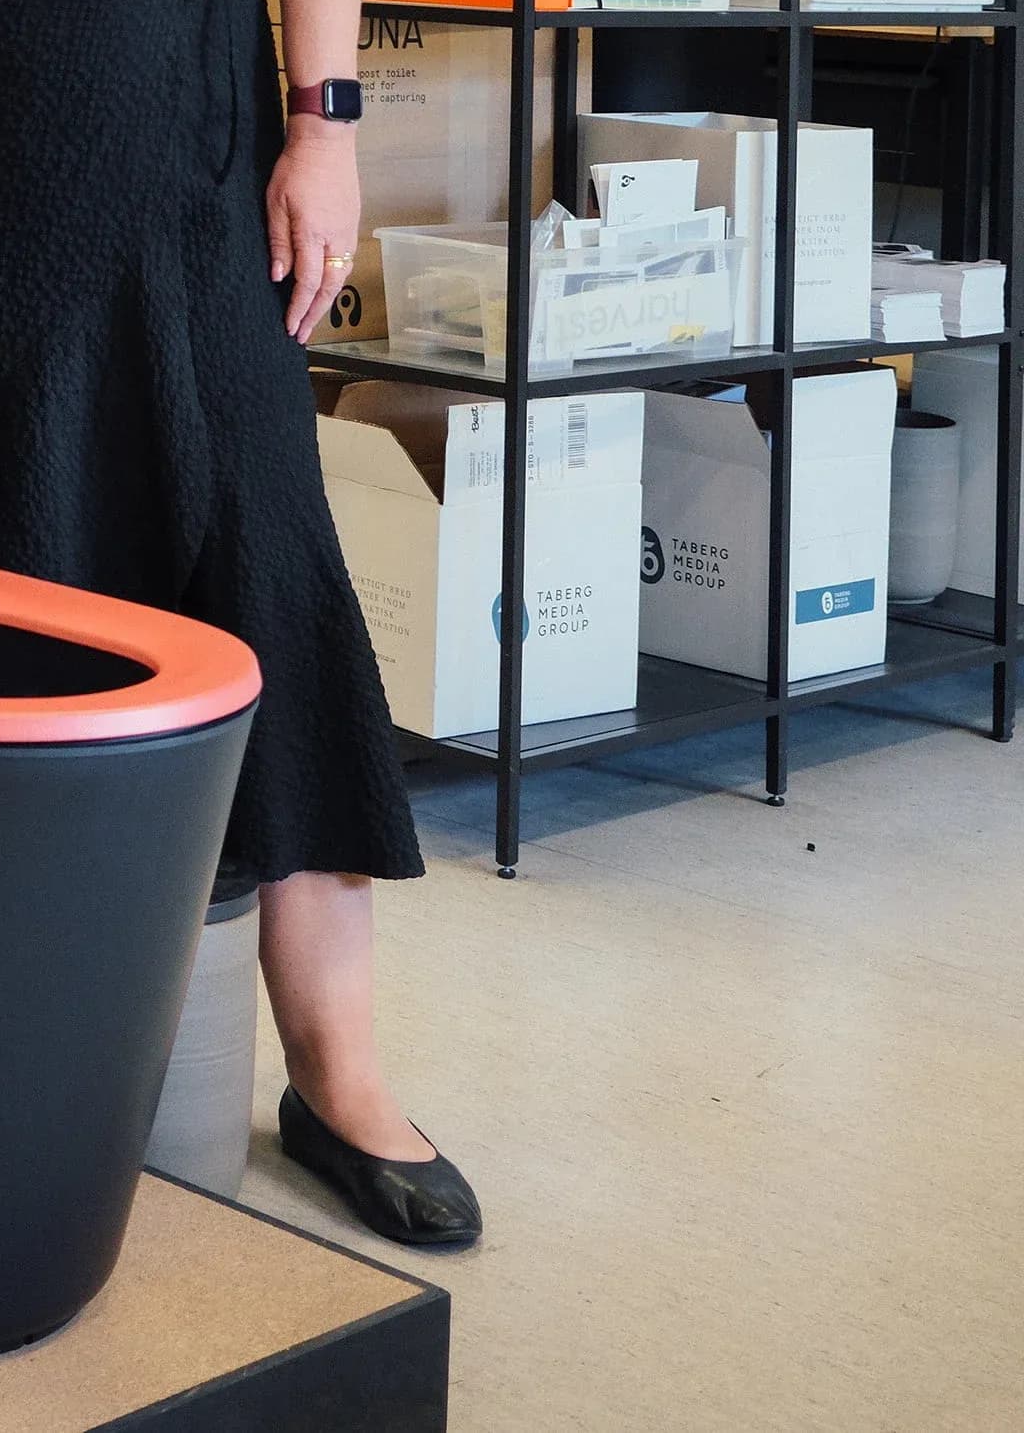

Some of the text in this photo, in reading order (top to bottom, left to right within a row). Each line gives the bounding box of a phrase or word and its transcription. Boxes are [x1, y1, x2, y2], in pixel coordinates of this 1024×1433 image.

[358, 68, 416, 80] post toilet
[380, 80, 396, 91] for
[379, 92, 426, 104] capturing
[672, 537, 729, 560] TABERG
[673, 554, 720, 574] MEDIA
[673, 570, 726, 589] GROUP
[536, 585, 592, 603] TABERG
[538, 603, 584, 619] MEDIA
[538, 619, 589, 636] GROUP
